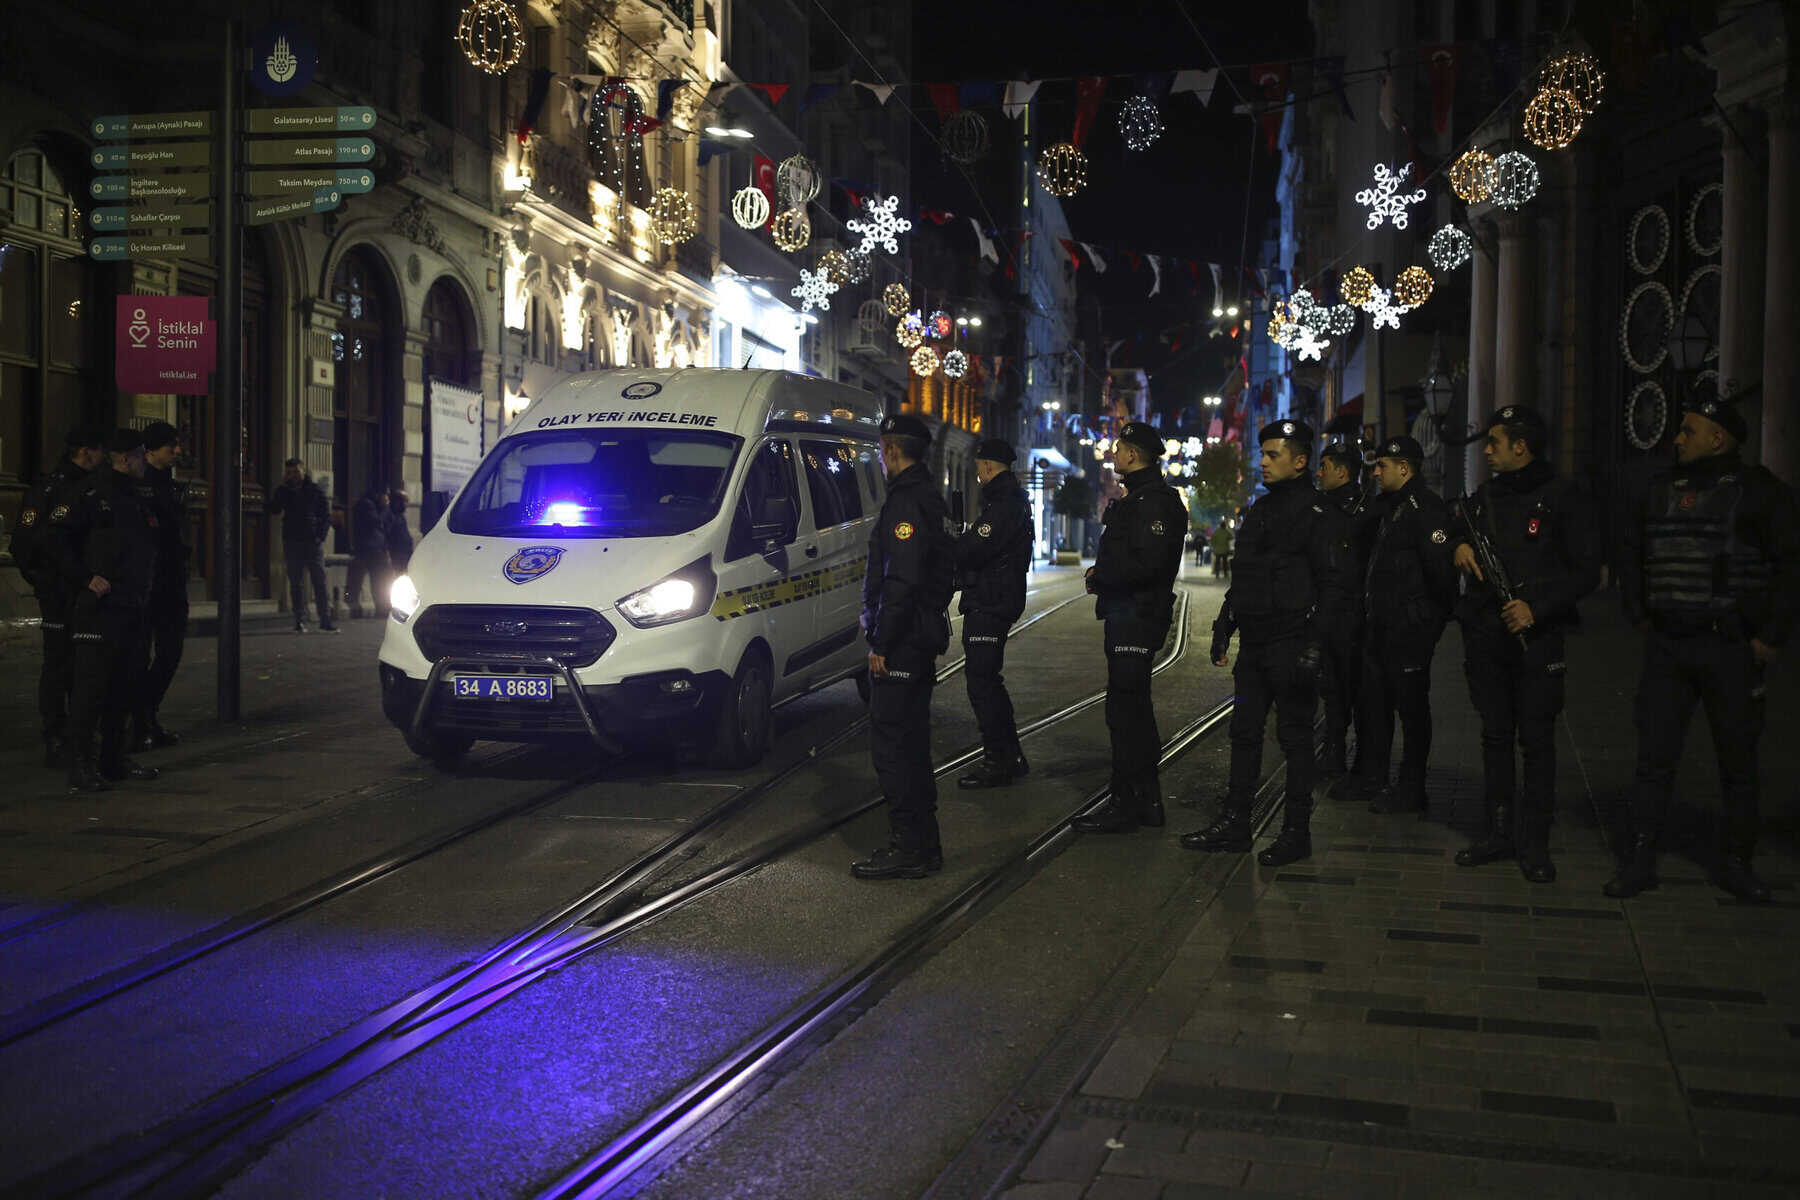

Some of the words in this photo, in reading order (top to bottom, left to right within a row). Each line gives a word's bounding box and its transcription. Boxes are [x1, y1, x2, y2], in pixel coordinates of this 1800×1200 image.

[273, 116, 313, 125] Galatasaray
[315, 115, 334, 123] Lisesi
[132, 122, 157, 131] Avrupa
[131, 152, 159, 162] Beyoğlu
[160, 151, 175, 159] Han
[295, 147, 312, 155] Atlas
[313, 147, 333, 156] Pasajı
[130, 178, 159, 187] İngiltere
[280, 179, 302, 187] Taksim
[303, 178, 333, 188] Meydanı
[131, 213, 157, 223] Sahaflar
[159, 213, 181, 223] Çarşısı
[130, 243, 140, 253] Üç
[162, 243, 186, 251] Kilisesi
[158, 318, 203, 335] İstiklal
[157, 335, 198, 349] Senin
[159, 370, 198, 379] istiklal.ist
[538, 413, 582, 428] OLAY
[459, 679, 480, 696] 34
[489, 679, 503, 696] A
[506, 679, 548, 697] 8683
